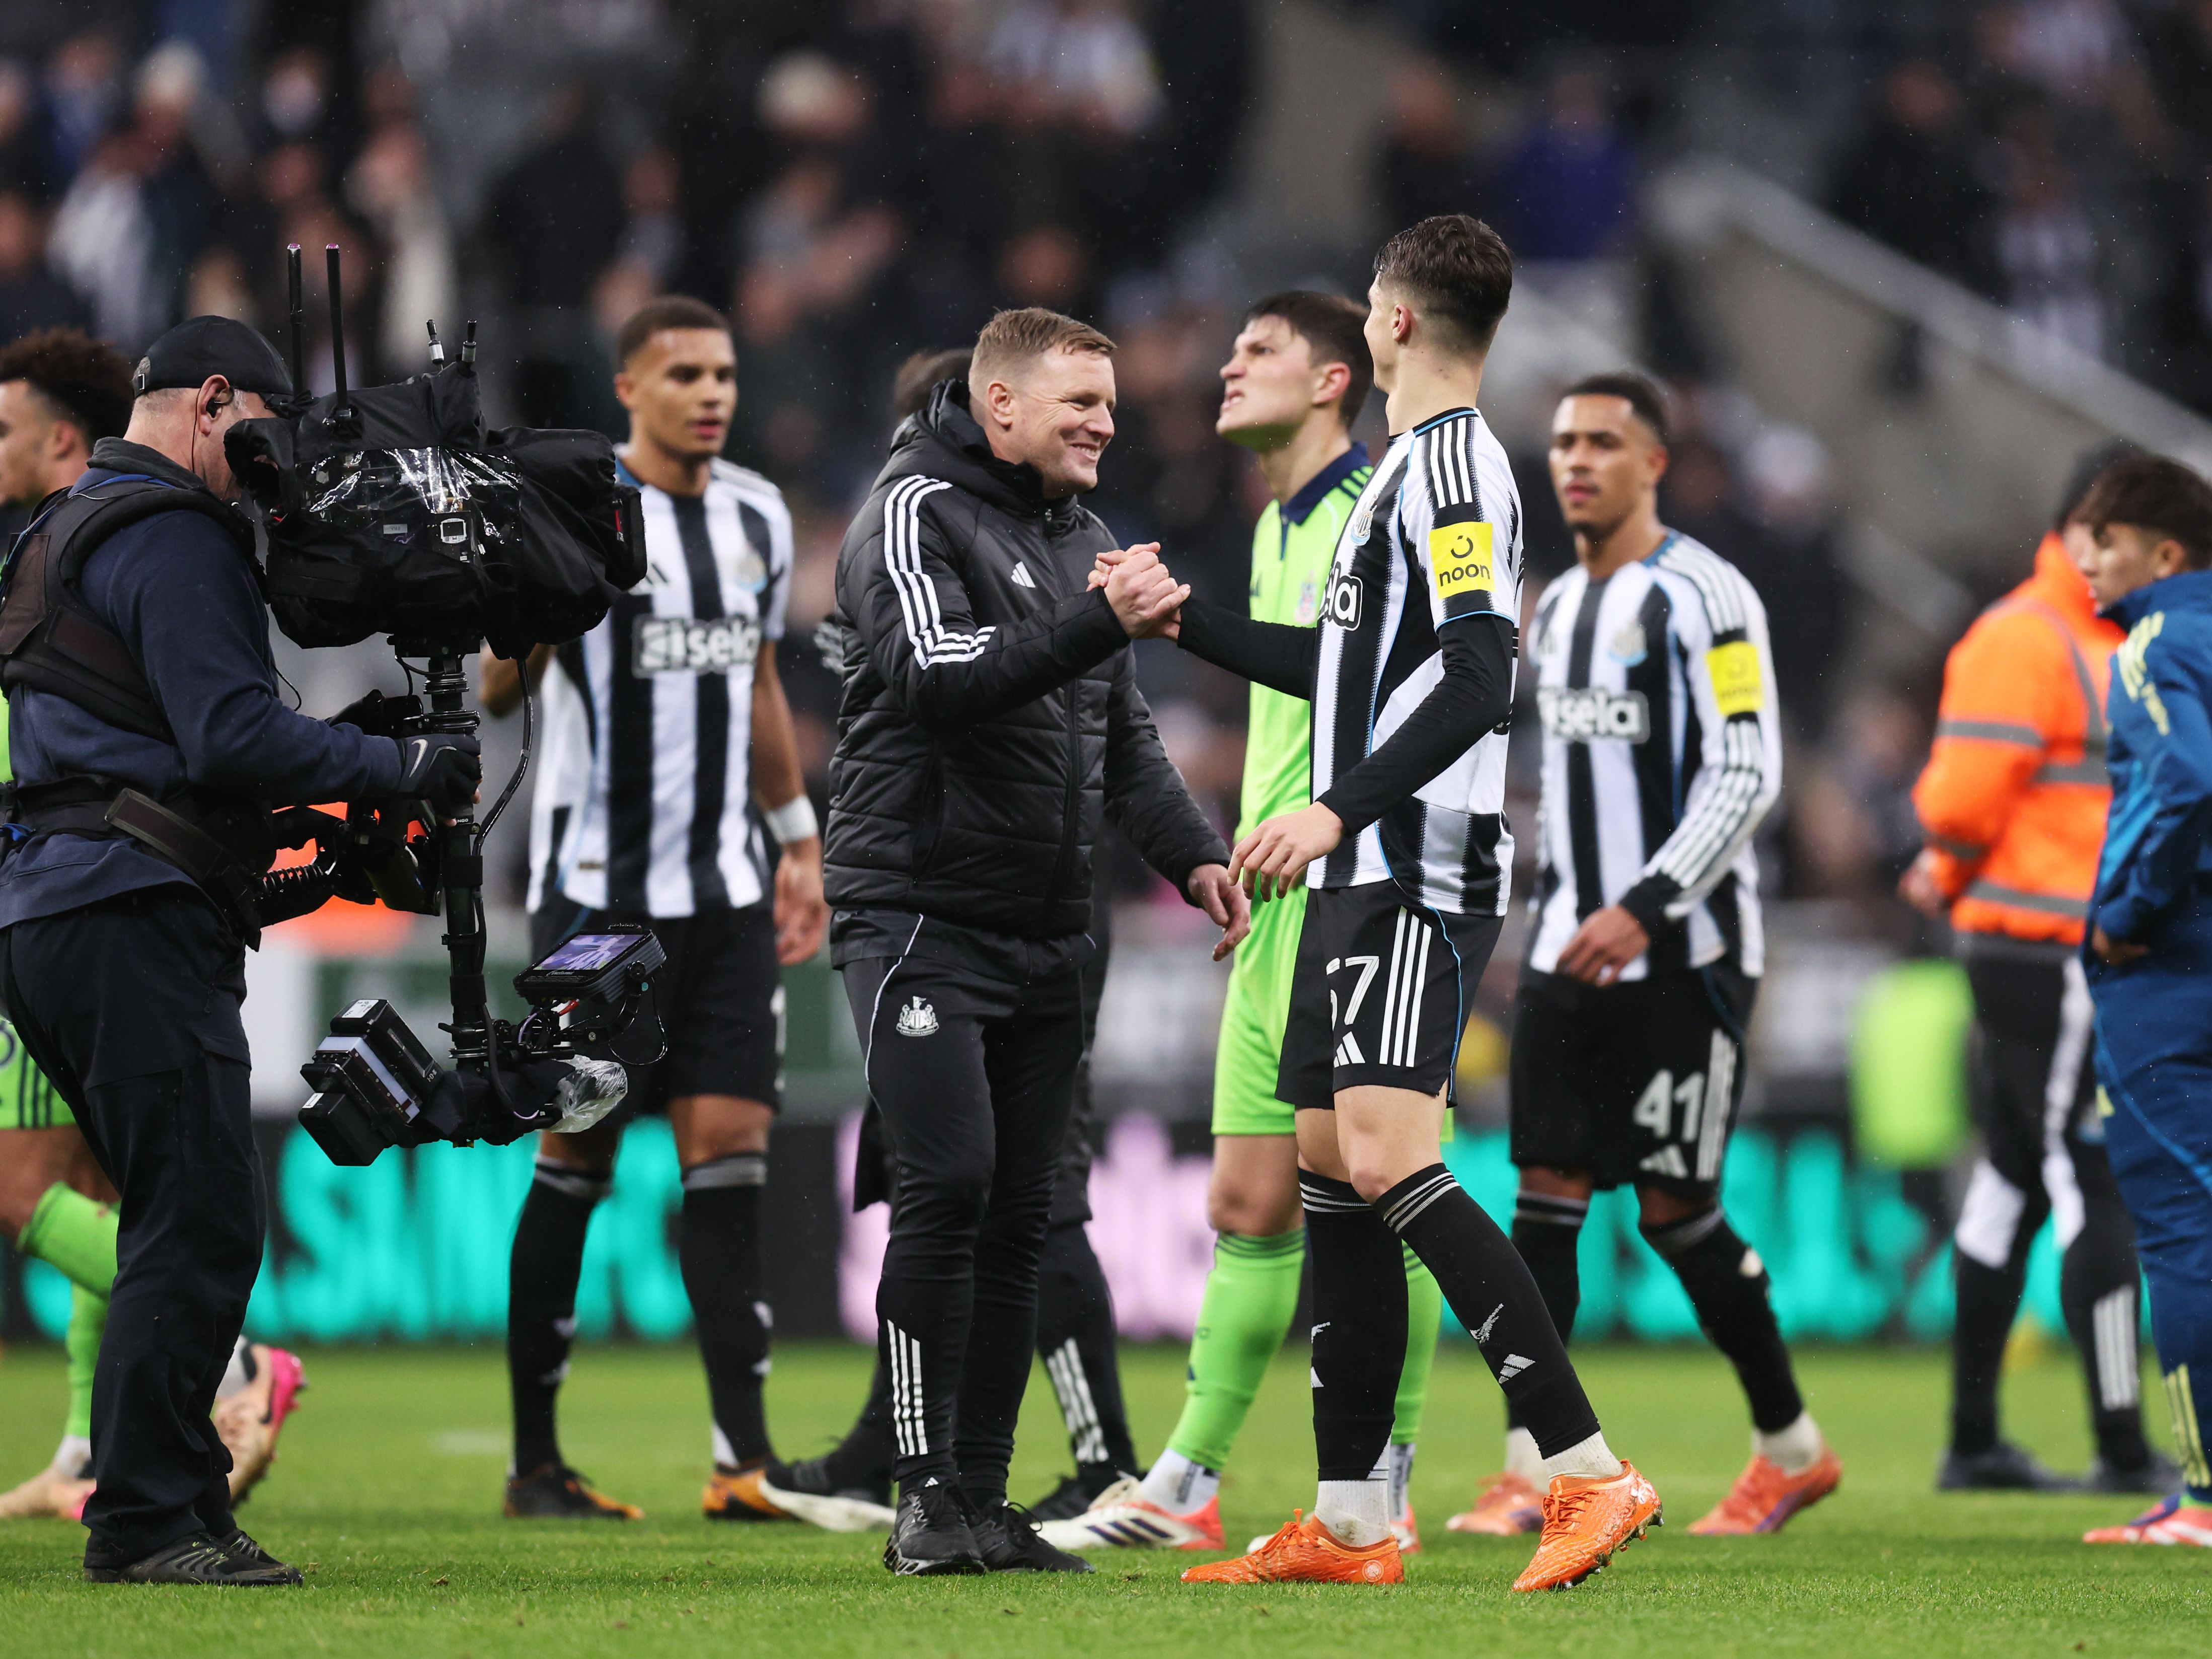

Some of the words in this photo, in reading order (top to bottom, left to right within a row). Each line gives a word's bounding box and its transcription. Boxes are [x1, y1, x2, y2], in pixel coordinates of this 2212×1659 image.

[1439, 564, 1491, 587] noon
[687, 620, 761, 666] sela
[1559, 691, 1641, 736] sela
[1633, 1069, 1705, 1142] 41
